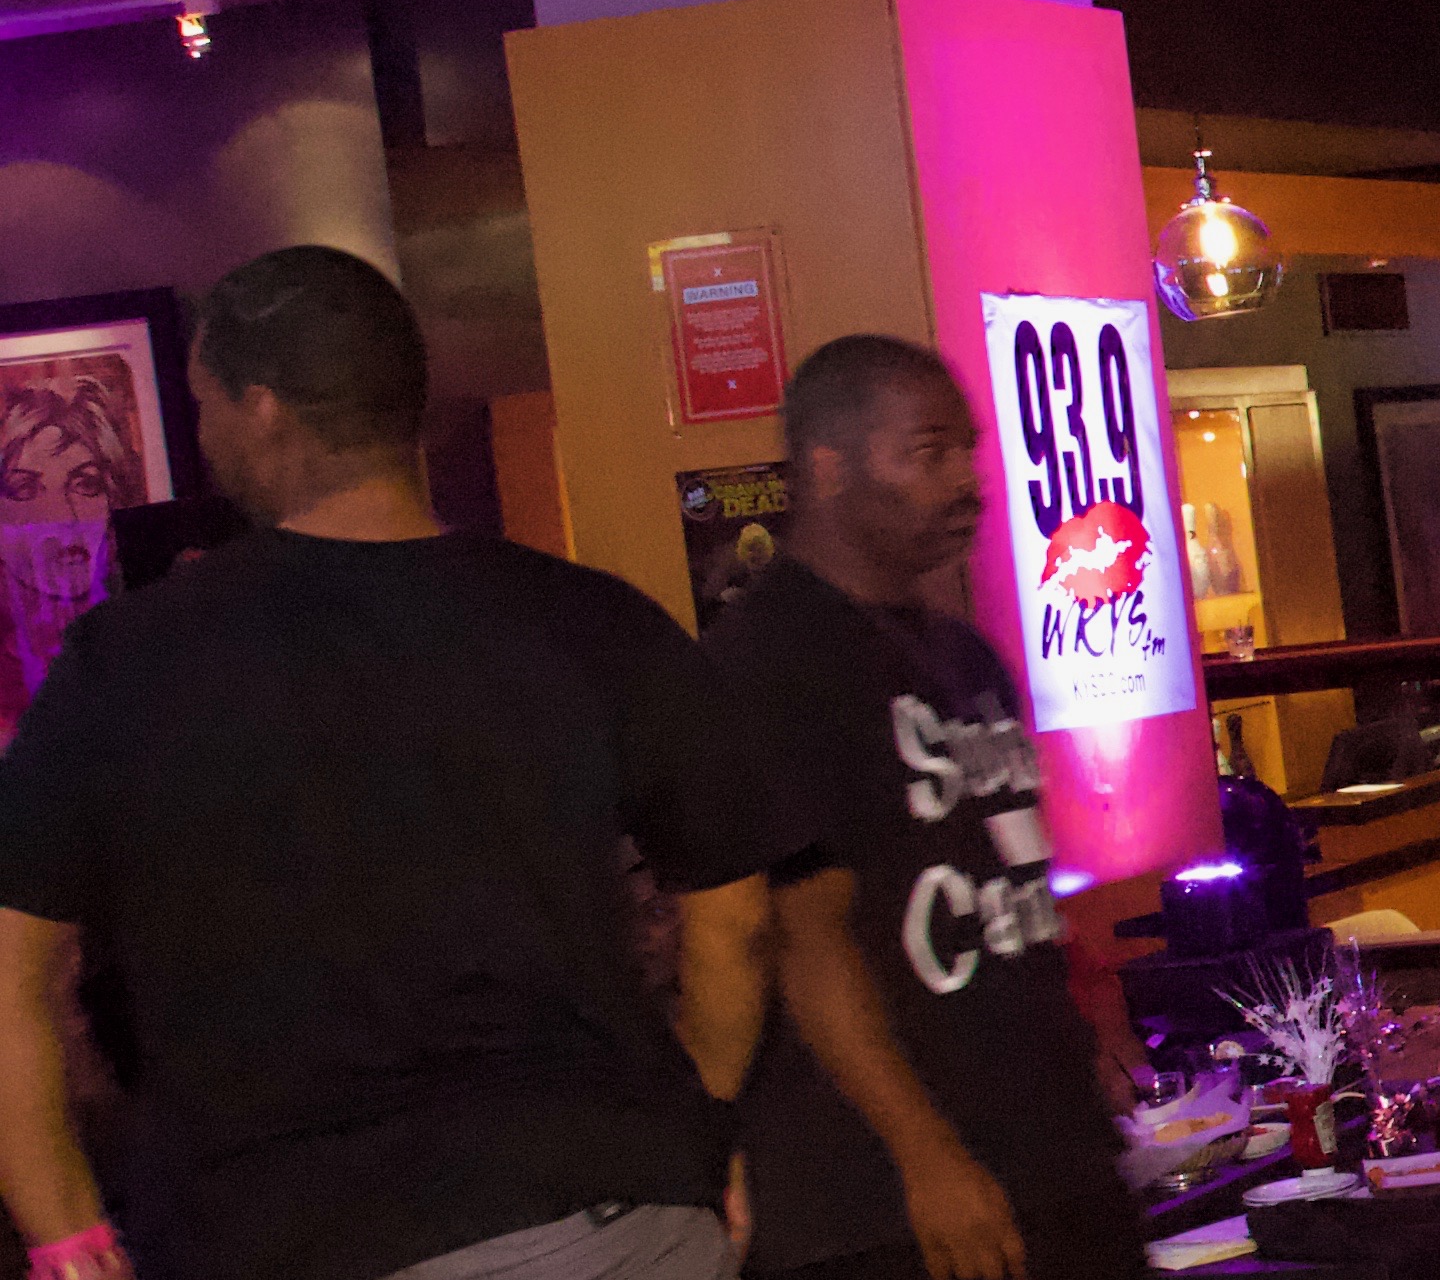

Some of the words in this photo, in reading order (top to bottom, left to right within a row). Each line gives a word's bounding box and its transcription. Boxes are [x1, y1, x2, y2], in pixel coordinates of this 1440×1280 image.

[686, 281, 756, 302] WARNING
[1014, 320, 1145, 540] 93.9
[1042, 590, 1147, 660] WKYS
